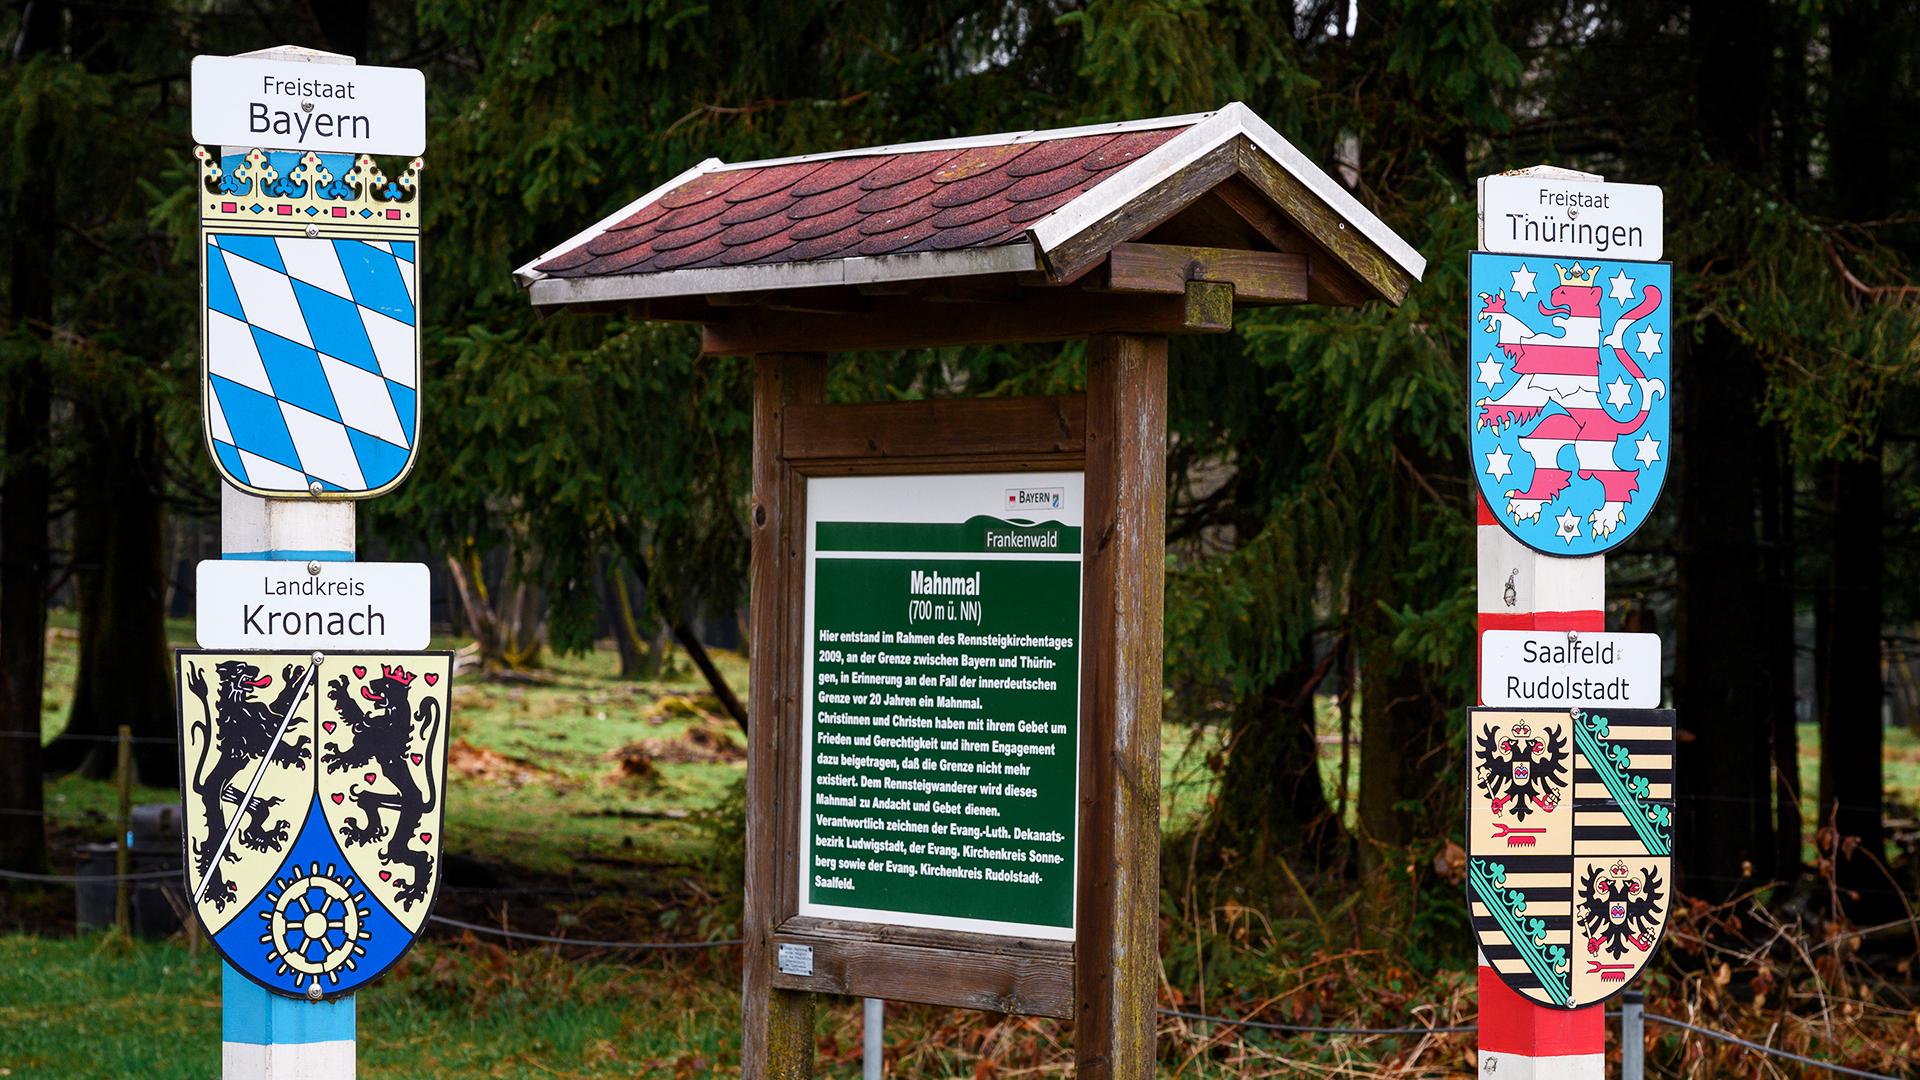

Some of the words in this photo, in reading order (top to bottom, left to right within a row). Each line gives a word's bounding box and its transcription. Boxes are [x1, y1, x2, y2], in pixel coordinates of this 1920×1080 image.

[264, 76, 355, 99] Freistaat
[250, 102, 372, 143] Bayern
[1540, 189, 1609, 209] Freistaat
[1506, 213, 1642, 252] Thüringen
[1019, 490, 1050, 504] BAYERN
[987, 531, 1057, 548] Frankenwald
[265, 576, 364, 596] Landkreis
[911, 570, 980, 596] Mahnmal
[244, 604, 384, 635] Kronach
[909, 600, 932, 625] (700
[934, 605, 945, 620] m
[947, 601, 957, 621] ü.
[960, 601, 982, 626] NN)
[819, 629, 839, 642] Hier
[840, 631, 880, 643] entstand
[882, 631, 894, 643] im
[896, 631, 935, 644] Rahmen
[937, 632, 955, 645] des
[957, 633, 1073, 651] Rennsteigkirchentages
[1523, 640, 1613, 664] Saalfeld
[819, 650, 844, 665] 2009,
[846, 653, 858, 663] an
[860, 651, 876, 664] der
[878, 651, 911, 665] Grenze
[913, 653, 959, 666] zwischen
[961, 654, 996, 670] Bayern
[998, 656, 1017, 668] und
[1019, 656, 1056, 669] Thürin-
[818, 673, 838, 685] gen,
[840, 671, 849, 683] in
[851, 671, 902, 688] Erinnerung
[904, 676, 917, 686] an
[919, 674, 937, 686] den
[939, 674, 957, 687] Fall
[960, 675, 977, 688] der
[979, 676, 1057, 690] innerdeutschen
[1507, 676, 1629, 700] Rudolstadt
[818, 691, 851, 704] Grenze
[852, 695, 868, 705] vor
[869, 693, 881, 705] 20
[883, 693, 916, 707] Jahren
[918, 695, 934, 707] ein
[937, 696, 983, 709] Mahnmal.
[818, 711, 870, 726] Christinnen
[872, 714, 890, 726] und
[892, 714, 933, 728] Christen
[935, 716, 965, 730] haben
[967, 718, 984, 731] mit
[986, 718, 1015, 732] ihrem
[1018, 720, 1049, 734] Gebet
[1051, 724, 1067, 734] um
[817, 732, 852, 745] Frieden
[854, 734, 871, 746] und
[873, 734, 938, 752] Gerechtigkeit
[940, 738, 959, 751] und
[961, 739, 989, 752] ihrem
[992, 740, 1055, 757] Engagement
[817, 752, 839, 765] dazu
[841, 753, 900, 771] beigetragen,
[902, 757, 920, 770] daß
[922, 758, 937, 771] die
[939, 759, 974, 773] Grenze
[976, 761, 1002, 774] nicht
[1004, 763, 1031, 776] mehr
[817, 773, 858, 787] existiert.
[861, 775, 882, 788] Dem
[884, 777, 978, 794] Rennsteigwanderer
[979, 782, 1002, 796] wird
[1004, 784, 1037, 798] dieses
[816, 793, 856, 807] Mahnmal
[859, 799, 870, 808] zu
[872, 797, 911, 811] Andacht
[913, 800, 930, 812] und
[932, 801, 961, 815] Gebet
[965, 803, 1000, 817] dienen.
[816, 813, 885, 830] Verantwortlich
[886, 819, 929, 833] zeichnen
[931, 822, 948, 834] der
[950, 823, 1011, 840] Evang.-Luth.
[1014, 827, 1065, 842] Dekanats-
[816, 834, 844, 848] bezirk
[846, 836, 907, 855] Ludwigstadt,
[909, 841, 926, 854] der
[927, 842, 960, 860] Evang.
[963, 845, 1027, 862] Kirchenkreis
[1029, 850, 1064, 864] Sonne-
[815, 854, 836, 871] berg
[838, 858, 866, 870] sowie
[868, 859, 884, 872] der
[886, 860, 918, 877] Evang.
[920, 863, 983, 880] Kirchenkreis
[985, 868, 1043, 884] Rudolstadt-
[815, 875, 855, 890] Saalfeld.
